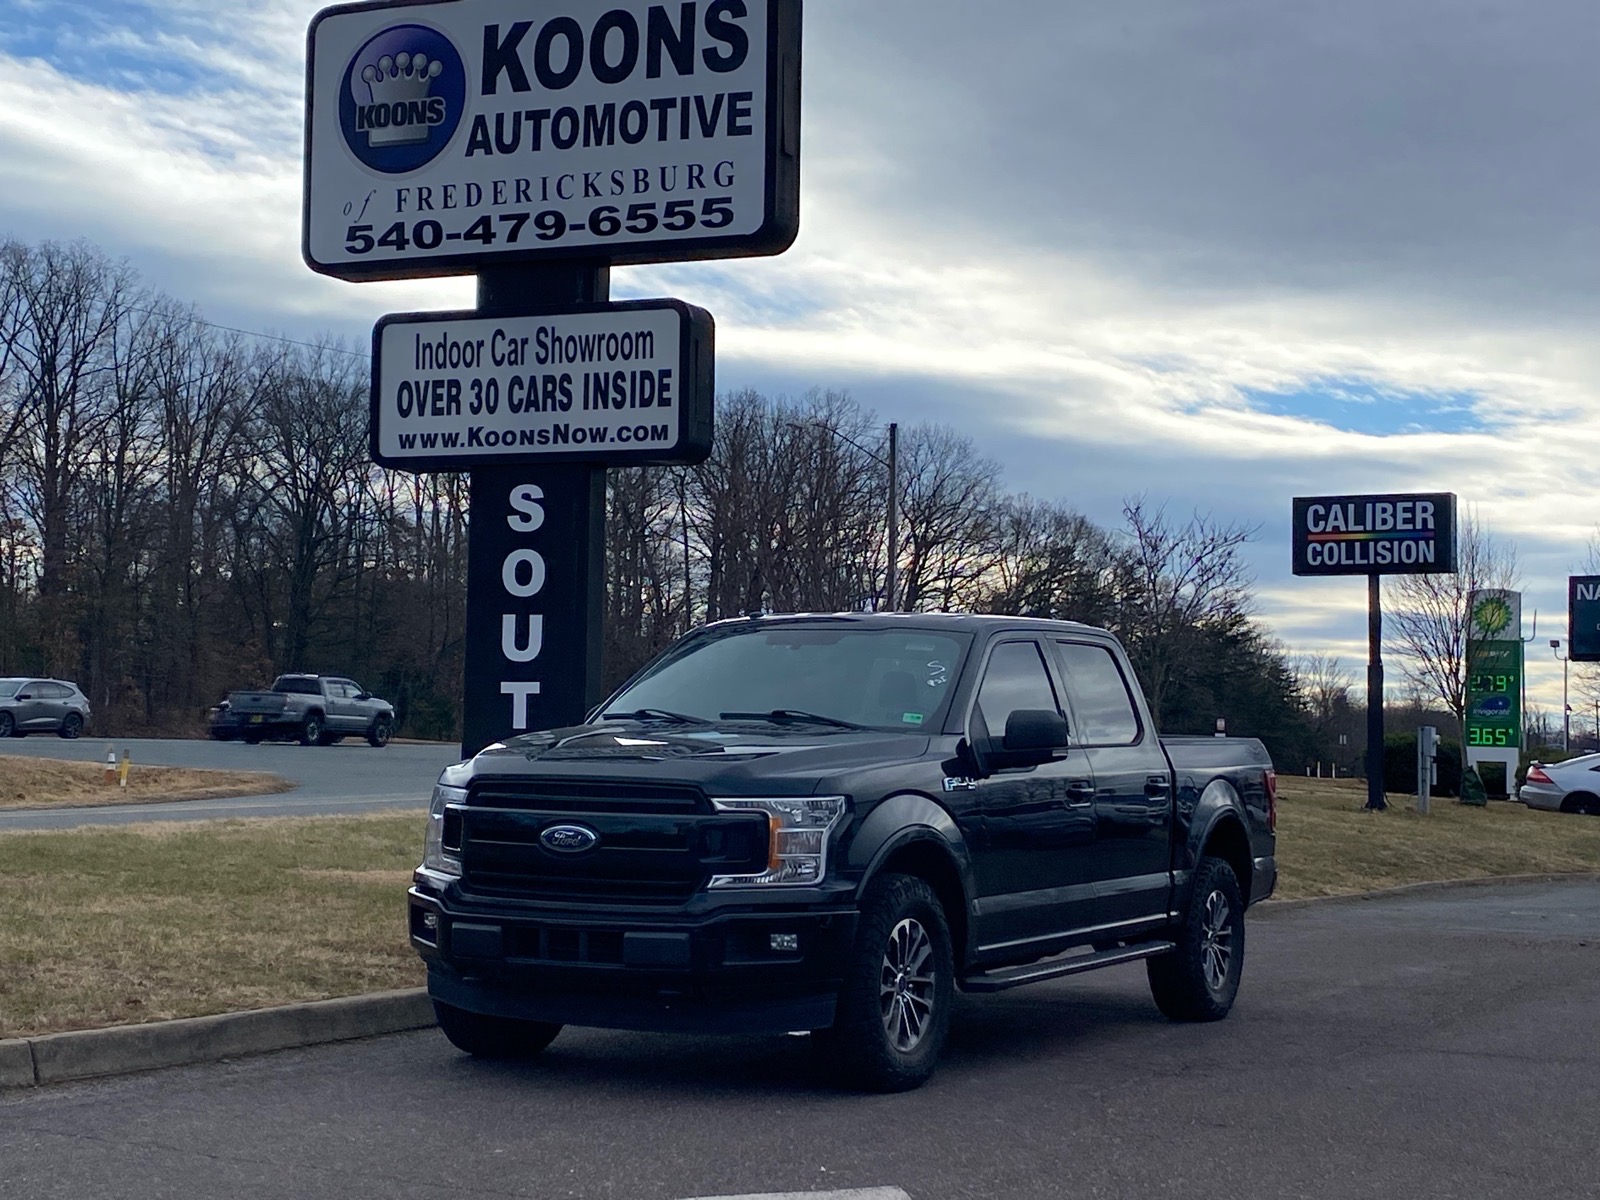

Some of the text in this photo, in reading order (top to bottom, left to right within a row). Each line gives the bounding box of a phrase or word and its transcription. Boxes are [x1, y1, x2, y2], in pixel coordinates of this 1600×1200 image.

[481, 0, 749, 95] KOONS
[357, 98, 444, 130] KOONS
[464, 91, 753, 157] AUTOMOTIVE
[343, 160, 736, 223] of FREDERICKSBURG
[345, 196, 735, 254] 540-479-6555
[415, 326, 654, 370] Indoor Car Showroom
[397, 369, 672, 418] OVER 30 CARS INSIDE
[1306, 501, 1435, 533] CALIBER
[1306, 540, 1435, 566] COLLISION
[552, 830, 582, 846] Ford
